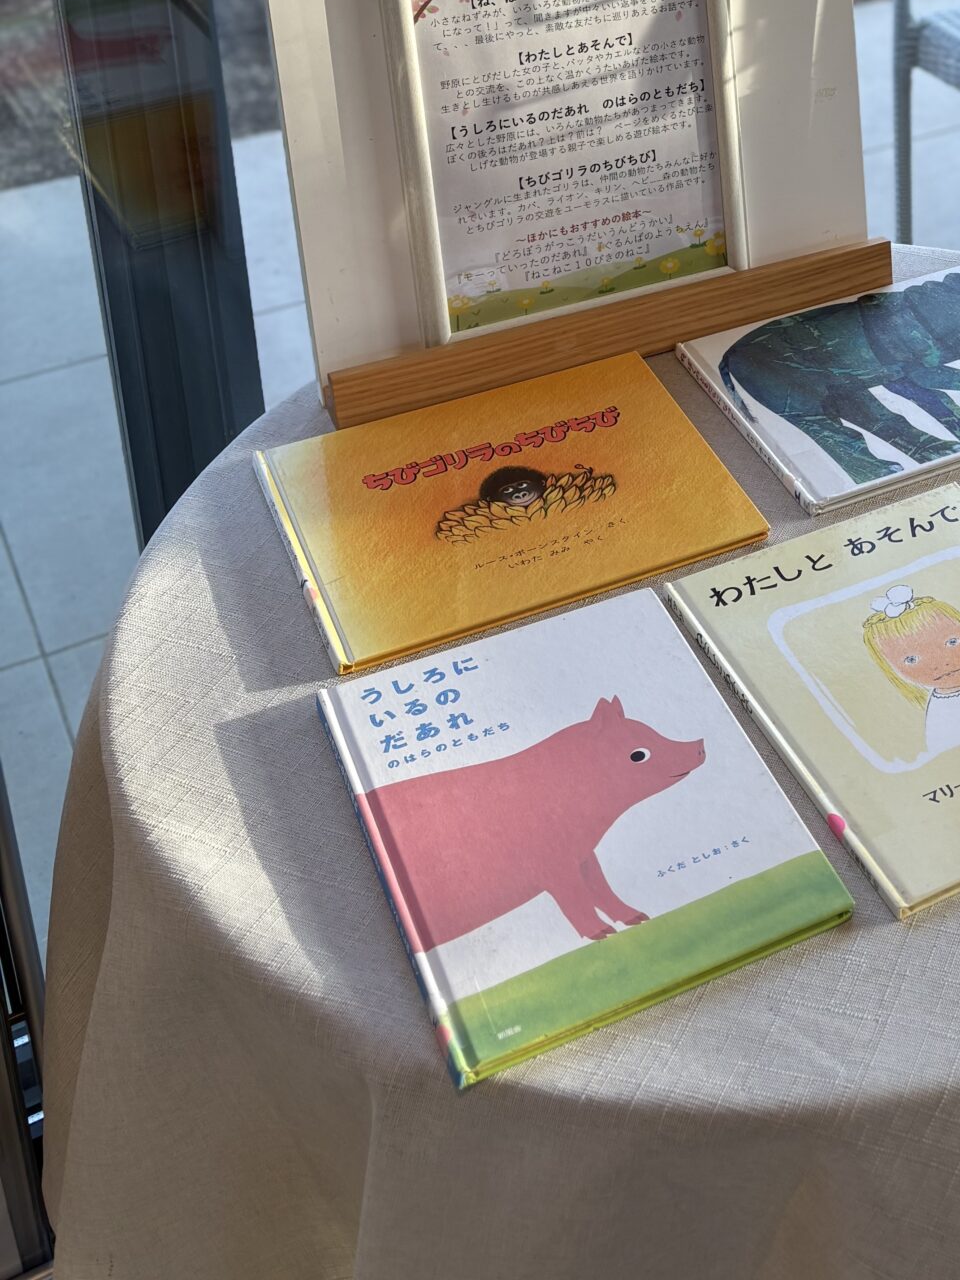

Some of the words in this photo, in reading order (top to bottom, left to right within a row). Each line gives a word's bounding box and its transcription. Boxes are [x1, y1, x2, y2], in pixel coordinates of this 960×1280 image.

[518, 32, 632, 65] 【わたしとあそんで】
[450, 101, 589, 140] 【うしろにいるのだあれ
[601, 77, 705, 110] のはらのともだち】
[518, 148, 656, 190] 【ちびゴリラのちびちび】
[361, 406, 621, 490] ちびゴリラのちびちび
[709, 553, 833, 607] わたしと
[843, 505, 960, 557] あそんで
[361, 657, 479, 705] うしろに
[369, 688, 461, 728] いるの
[379, 712, 474, 754] だあれ
[387, 722, 510, 769] のはらのともだち
[657, 861, 687, 878] ふくだ
